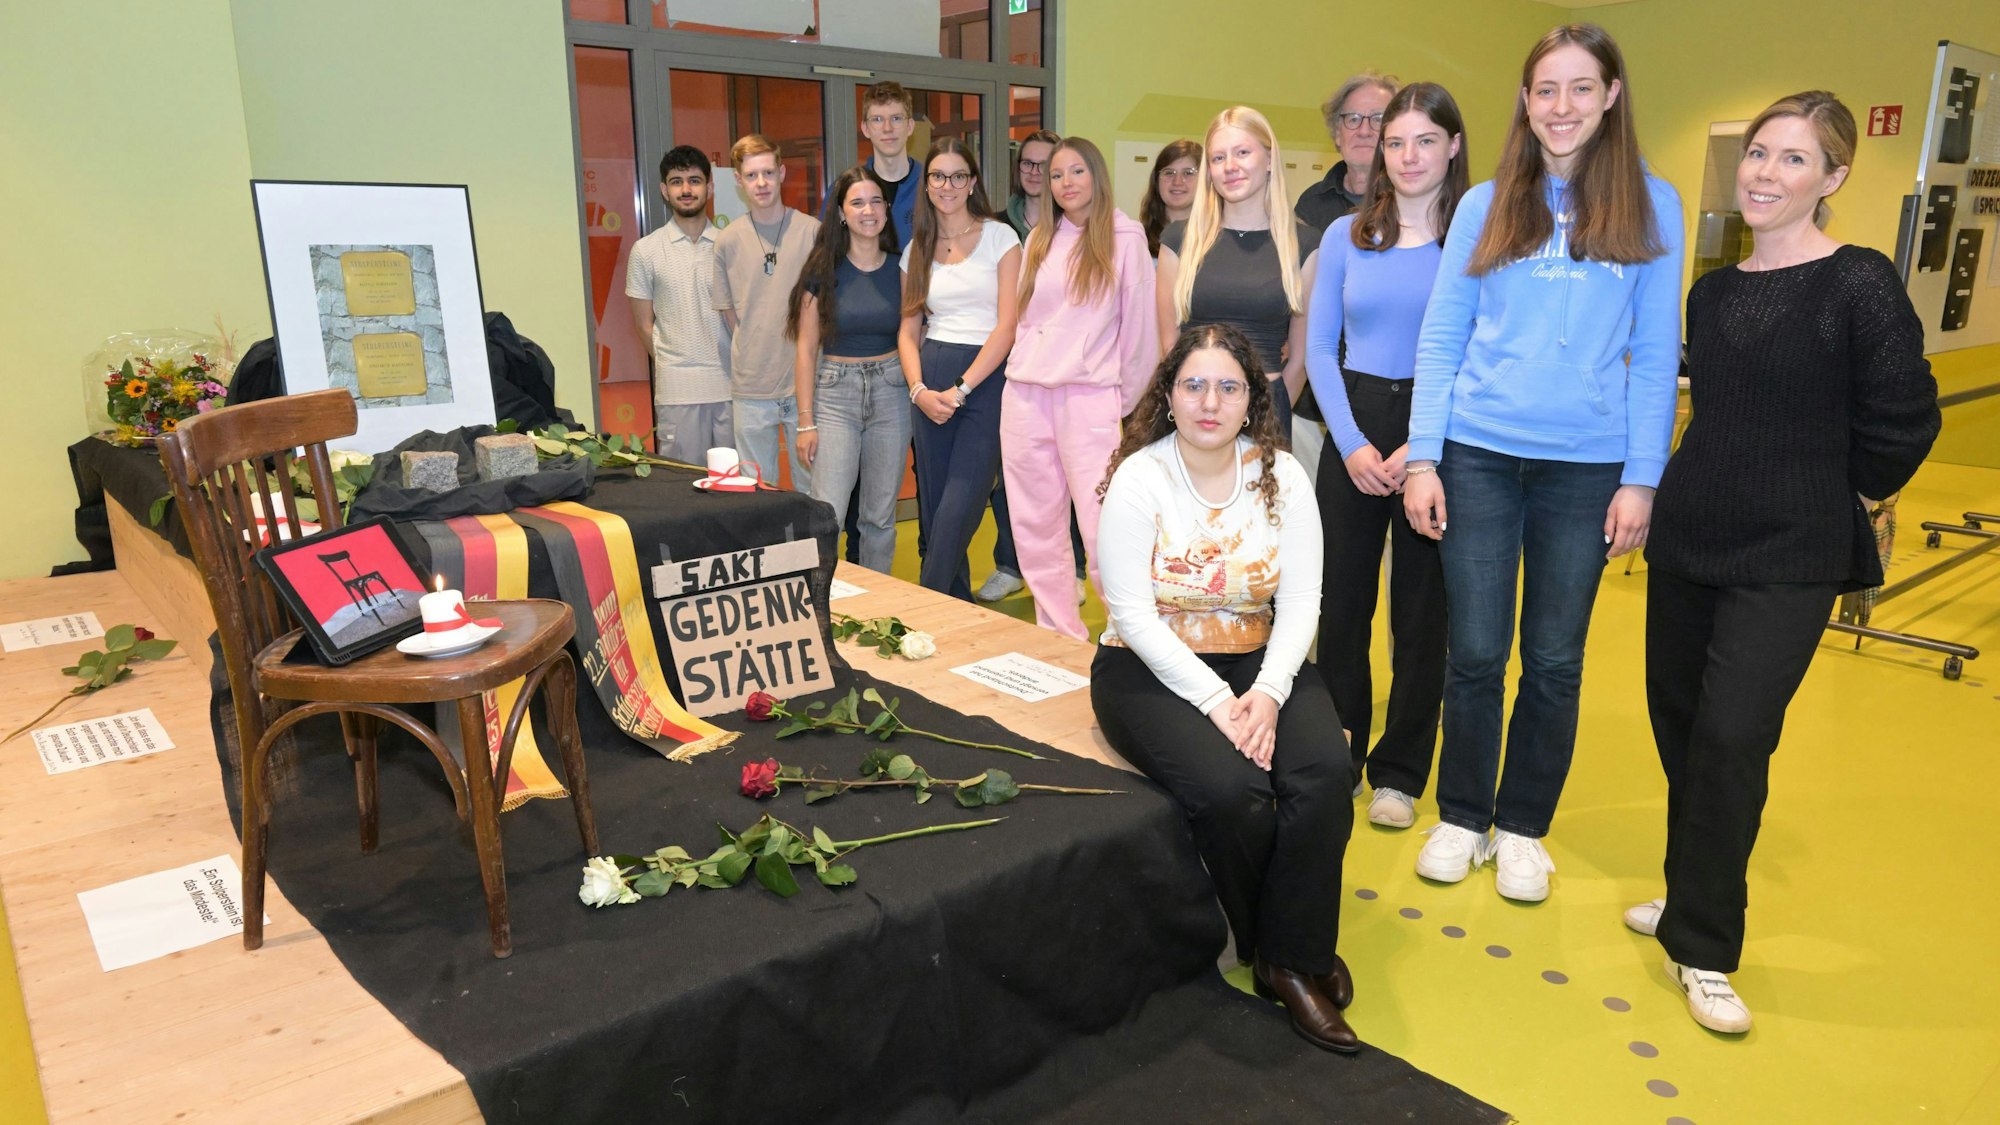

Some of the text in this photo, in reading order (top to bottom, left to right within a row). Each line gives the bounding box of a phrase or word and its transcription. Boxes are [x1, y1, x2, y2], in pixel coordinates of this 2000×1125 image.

[670, 581, 813, 642] GEDENK-
[683, 638, 819, 703] STÄTTE
[184, 880, 197, 891] das
[209, 879, 239, 917] Stolperstein
